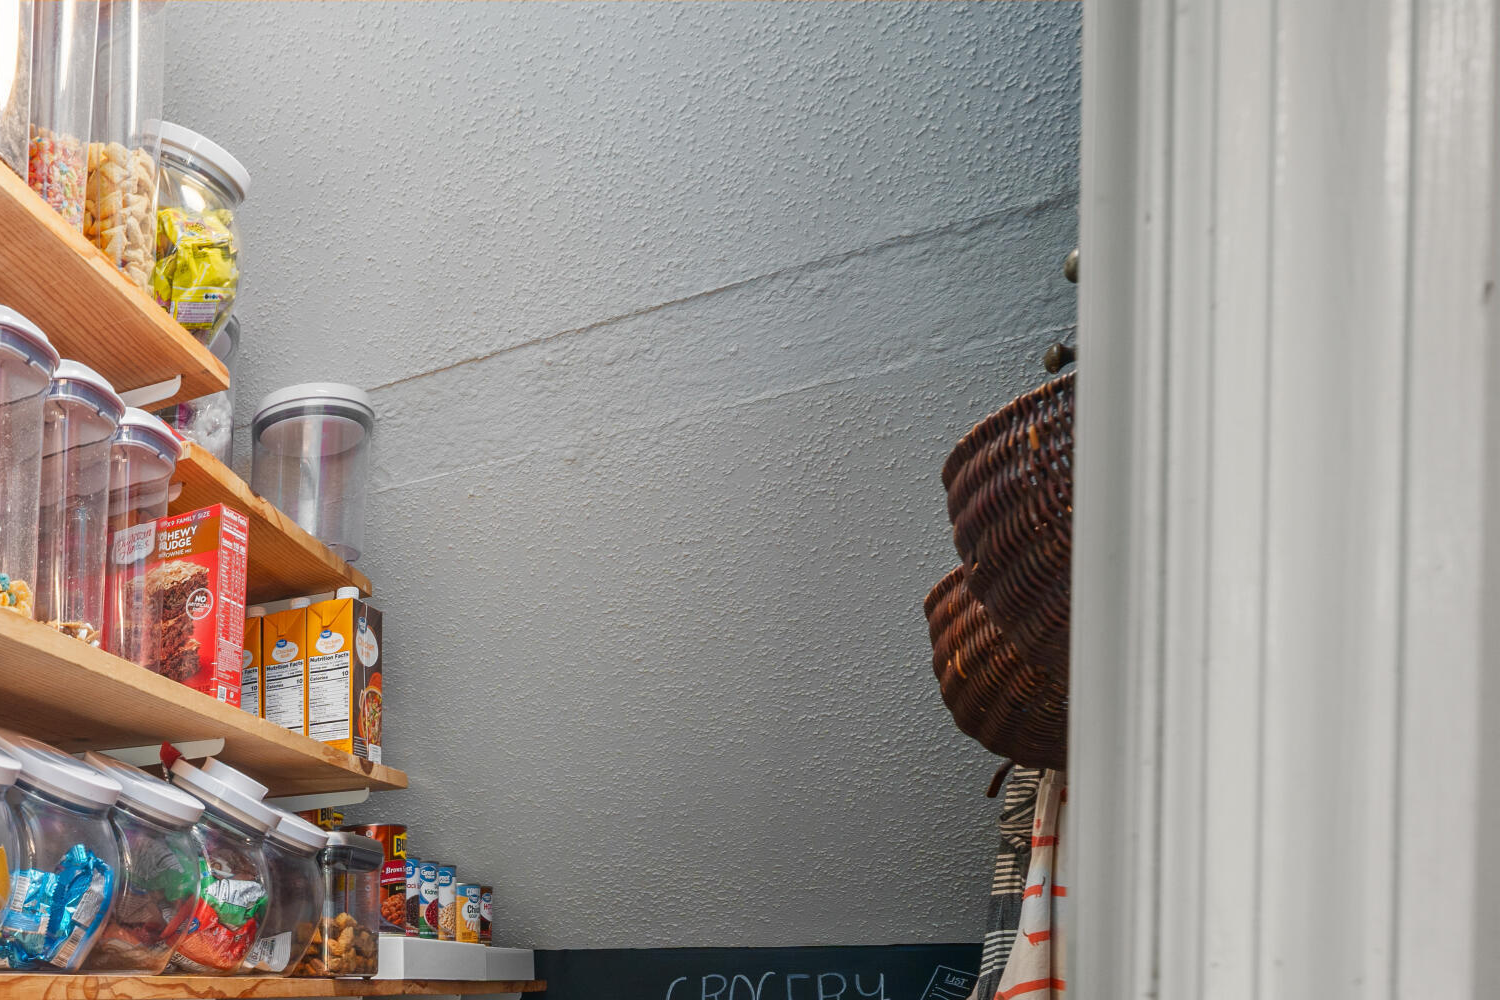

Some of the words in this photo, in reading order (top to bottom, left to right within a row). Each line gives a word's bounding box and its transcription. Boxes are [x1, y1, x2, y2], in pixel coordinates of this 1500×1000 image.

[195, 595, 206, 603] NO
[310, 654, 333, 663] Nutrition
[335, 652, 349, 660] Facts
[266, 664, 288, 672] Nutrition
[945, 973, 967, 987] LIST
